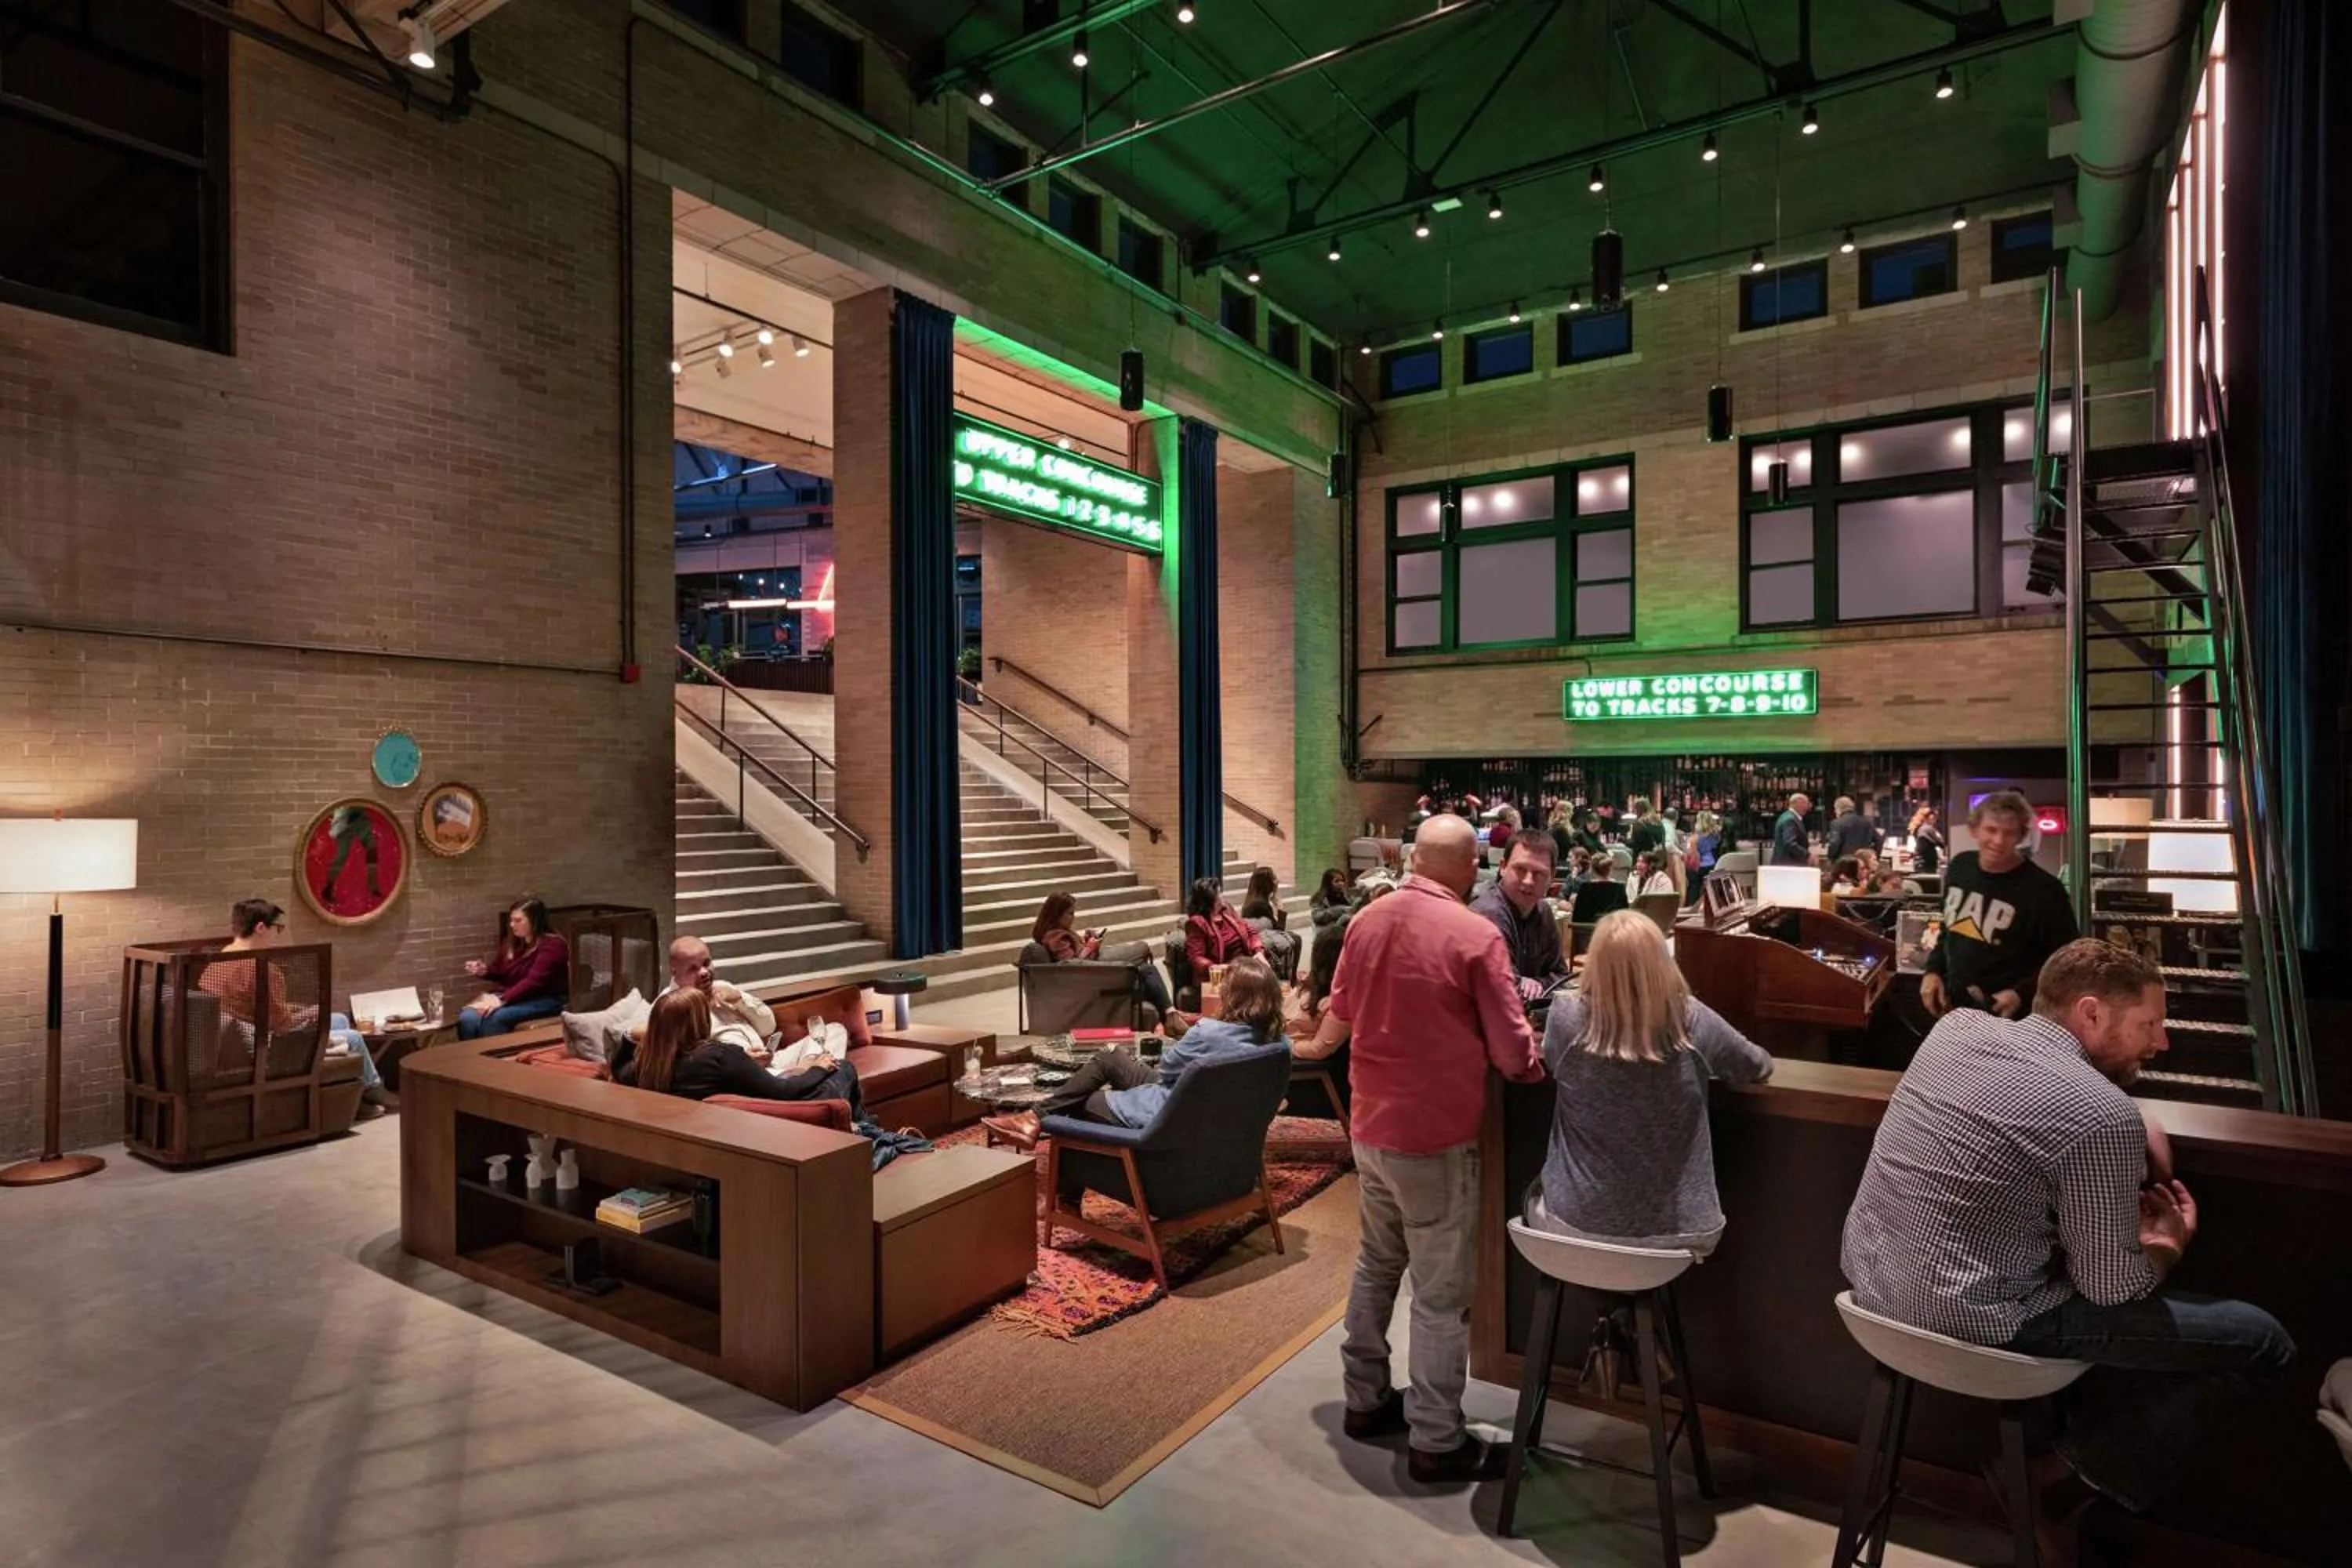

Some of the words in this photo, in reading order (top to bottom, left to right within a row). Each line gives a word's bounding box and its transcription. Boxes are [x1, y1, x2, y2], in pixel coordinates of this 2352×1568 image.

[1571, 679, 1642, 698] LOWER
[1651, 672, 1804, 695] CONCOURSE
[1571, 698, 1599, 717] TO
[1606, 696, 1697, 715] TRACKS
[1704, 692, 1808, 713] 7-8-9-10
